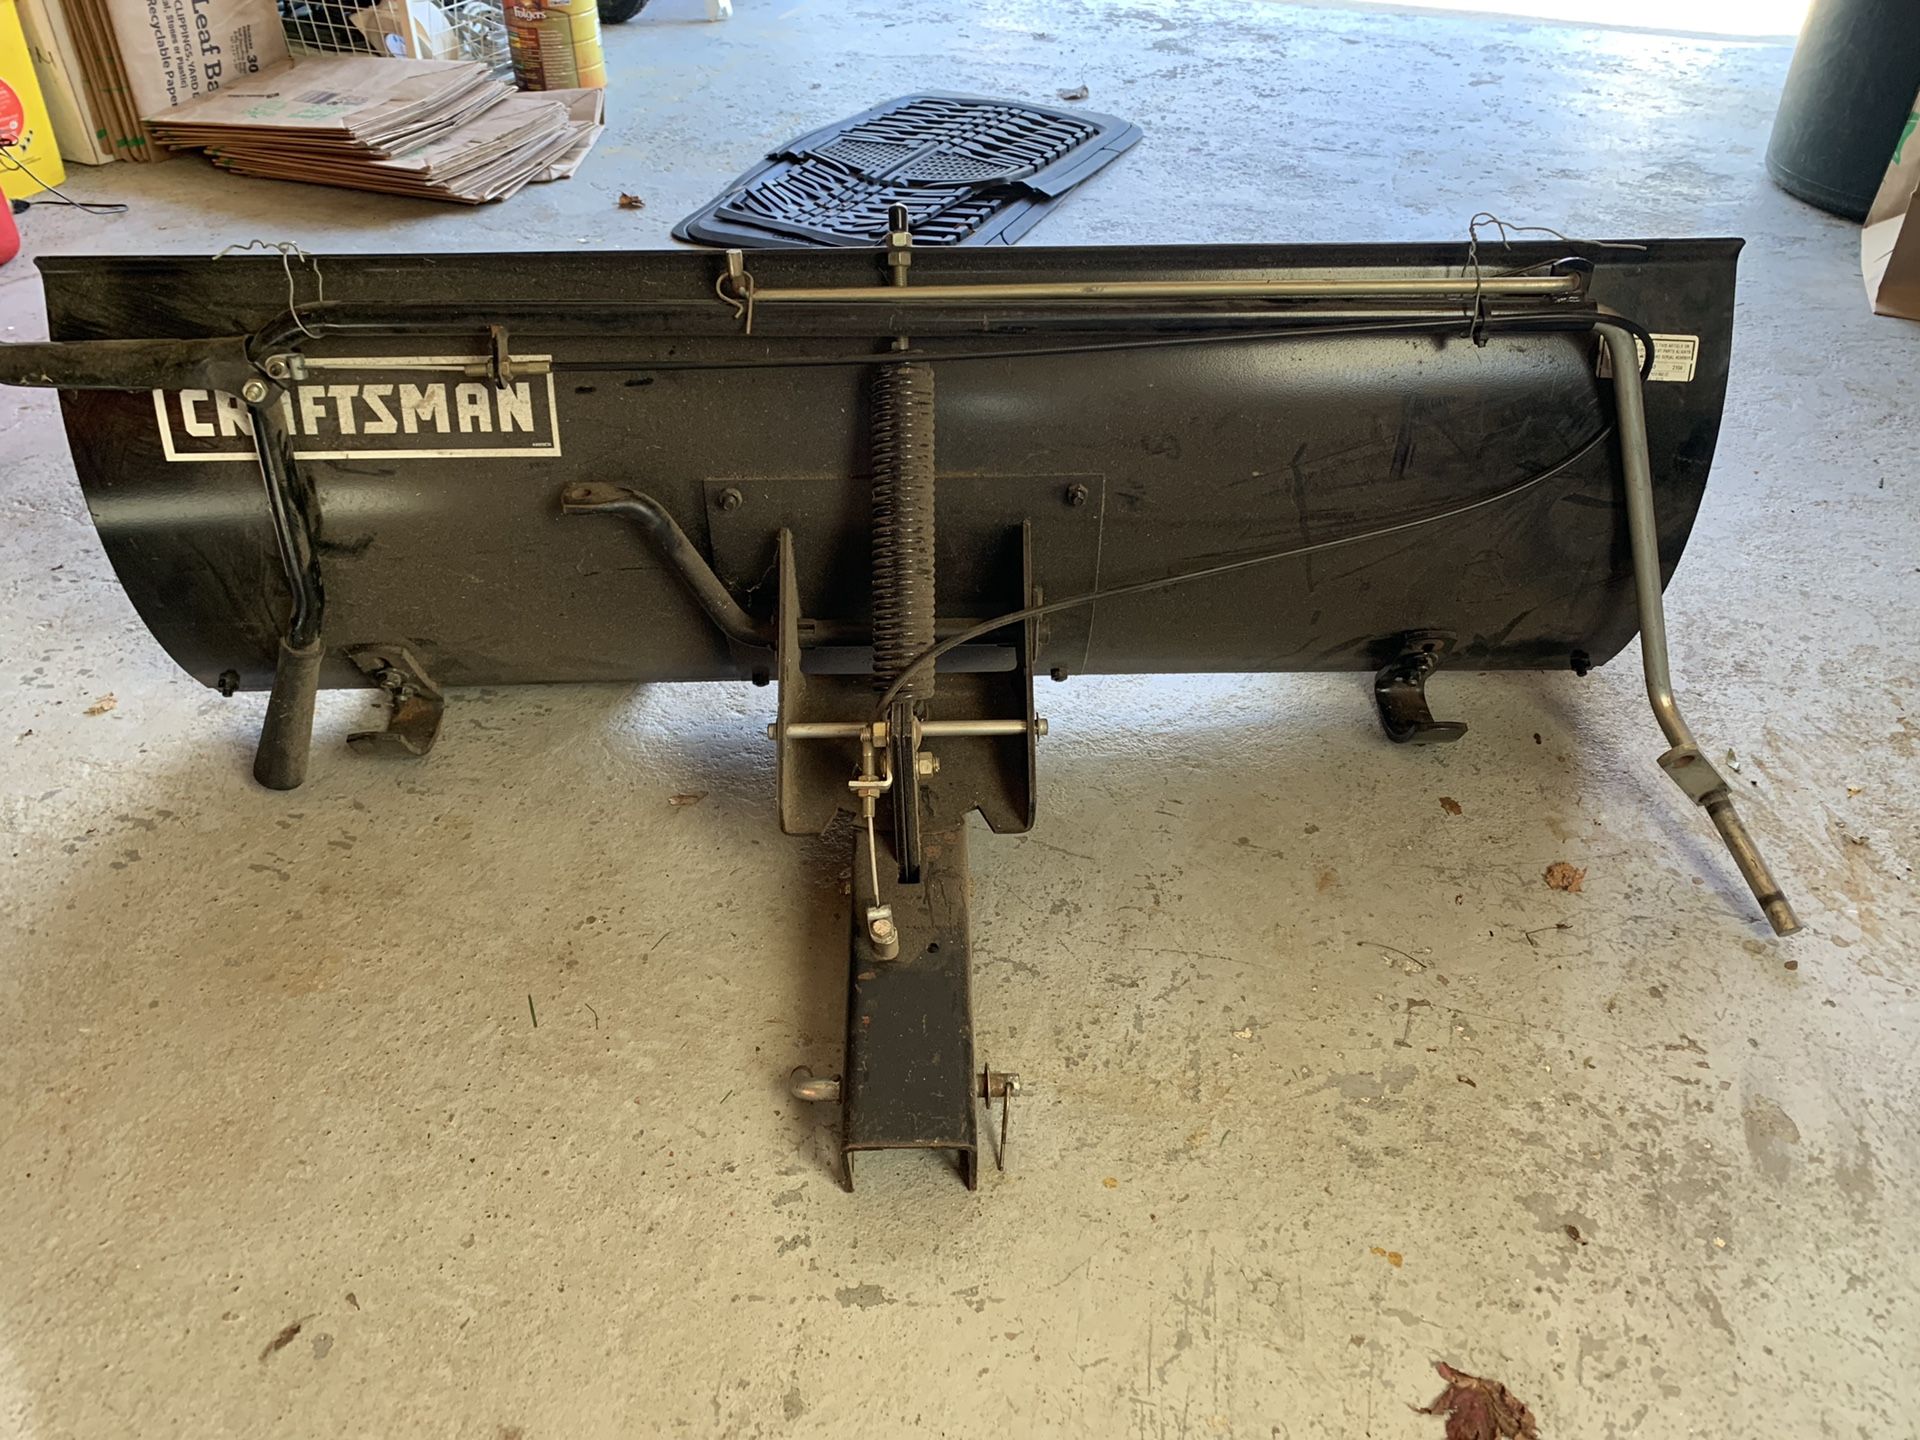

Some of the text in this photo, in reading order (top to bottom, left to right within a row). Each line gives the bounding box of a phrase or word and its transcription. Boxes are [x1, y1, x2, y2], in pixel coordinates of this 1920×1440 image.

[513, 6, 546, 21] Folgers
[147, 0, 171, 68] Recyclable
[192, 0, 222, 92] Leaf Ba
[188, 61, 199, 91] YARD
[247, 55, 259, 73] 30
